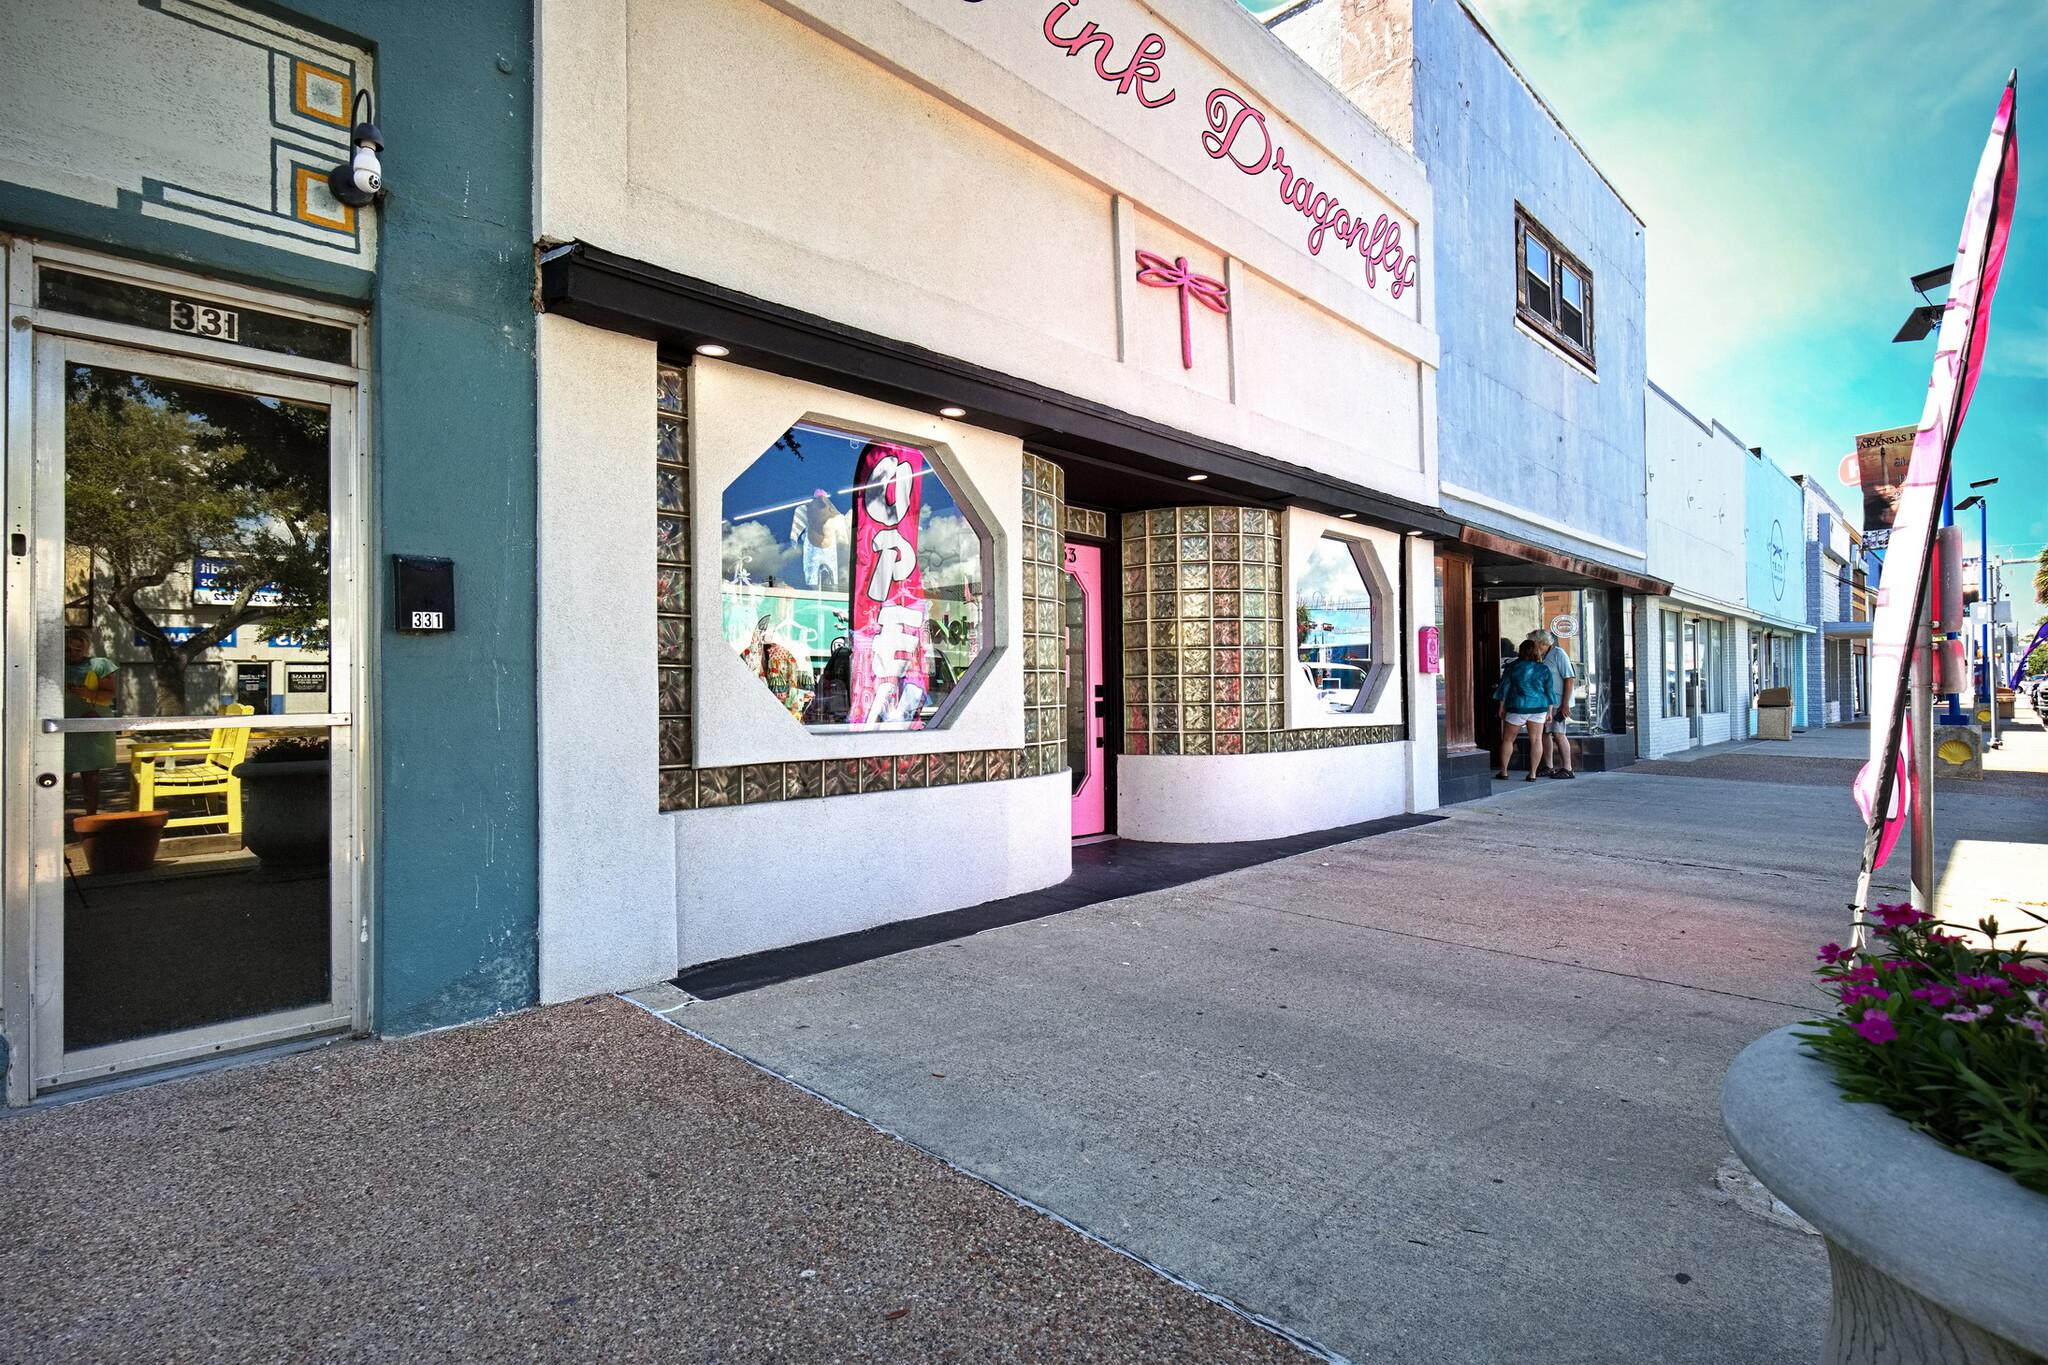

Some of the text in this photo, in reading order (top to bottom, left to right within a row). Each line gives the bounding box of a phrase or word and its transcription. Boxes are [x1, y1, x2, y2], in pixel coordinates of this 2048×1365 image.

[1043, 0, 1415, 299] ink Dragonfly
[173, 303, 236, 340] 331
[1859, 434, 1907, 450] ARANSAS
[414, 613, 441, 628] 331
